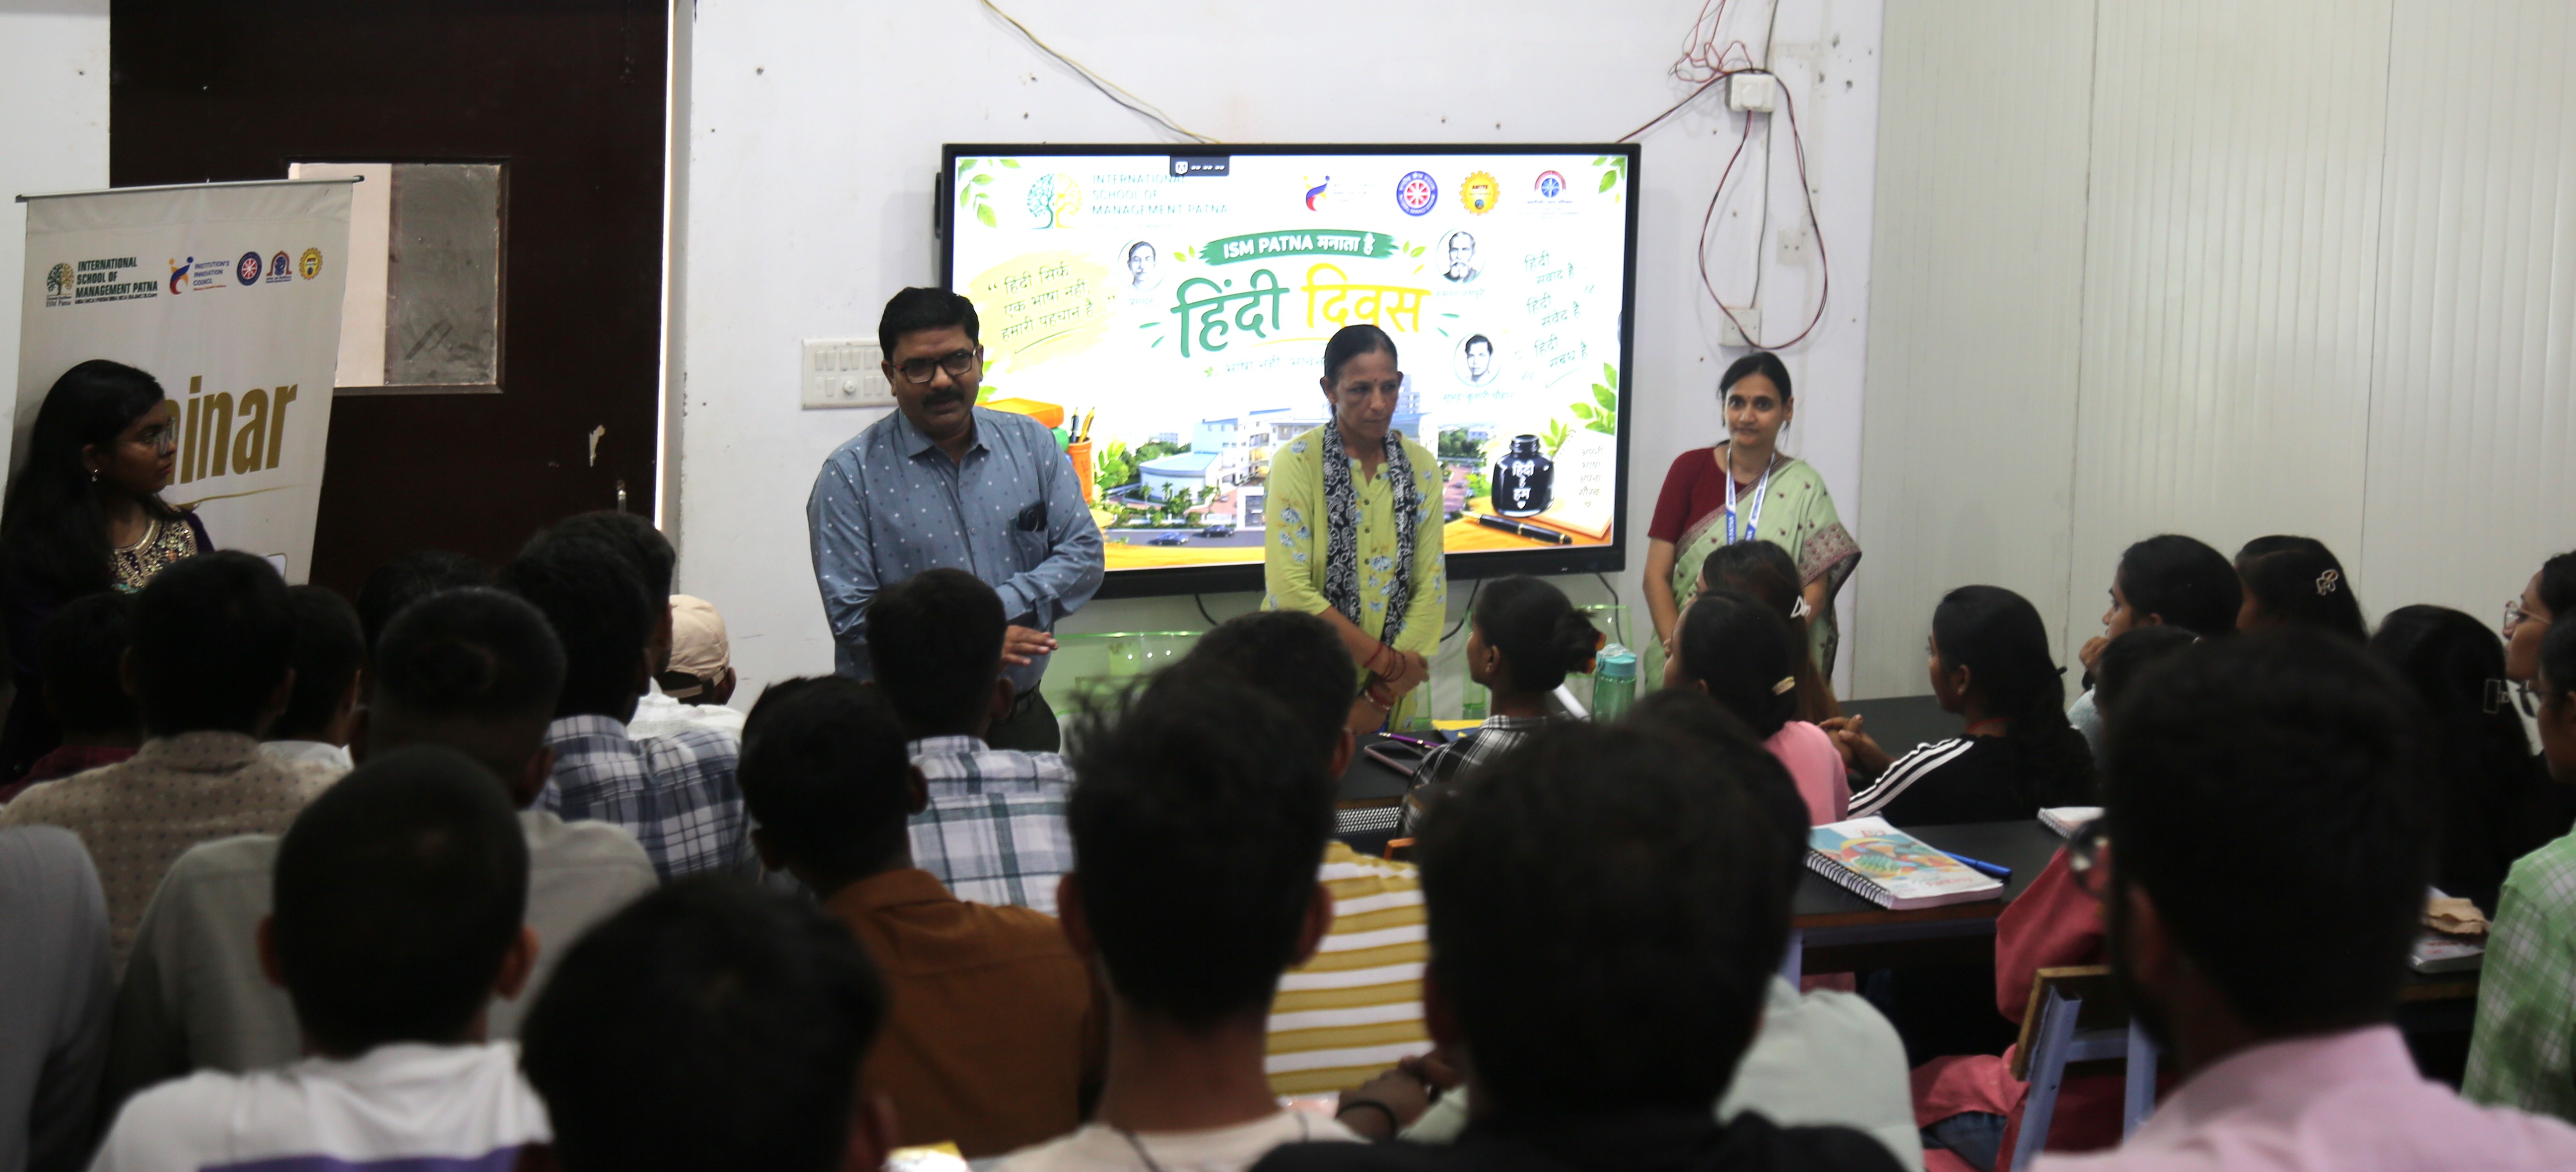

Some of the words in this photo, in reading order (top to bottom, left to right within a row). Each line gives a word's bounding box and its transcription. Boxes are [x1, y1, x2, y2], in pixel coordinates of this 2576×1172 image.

[1093, 190, 1138, 200] SCHOOL
[1144, 190, 1157, 199] OF
[1093, 205, 1182, 214] MANAGEMENT
[1188, 205, 1228, 214] PATNA
[1223, 239, 1255, 259] ISM
[1258, 234, 1314, 254] PATNA
[1317, 235, 1361, 252] मनाता
[1363, 232, 1375, 255] है
[78, 257, 137, 272] INTERNATIONAL
[76, 272, 106, 285] SCHOOL
[108, 271, 118, 282] OF
[1004, 271, 1032, 294] हिंदी
[75, 283, 131, 298] MANAGEMENT
[133, 280, 158, 293] PATNA
[1004, 300, 1026, 318] एक
[1170, 269, 1290, 358] हिंदी
[1300, 263, 1431, 333] दिवस
[1001, 316, 1033, 342] हमारी
[1039, 305, 1081, 328] पहचान
